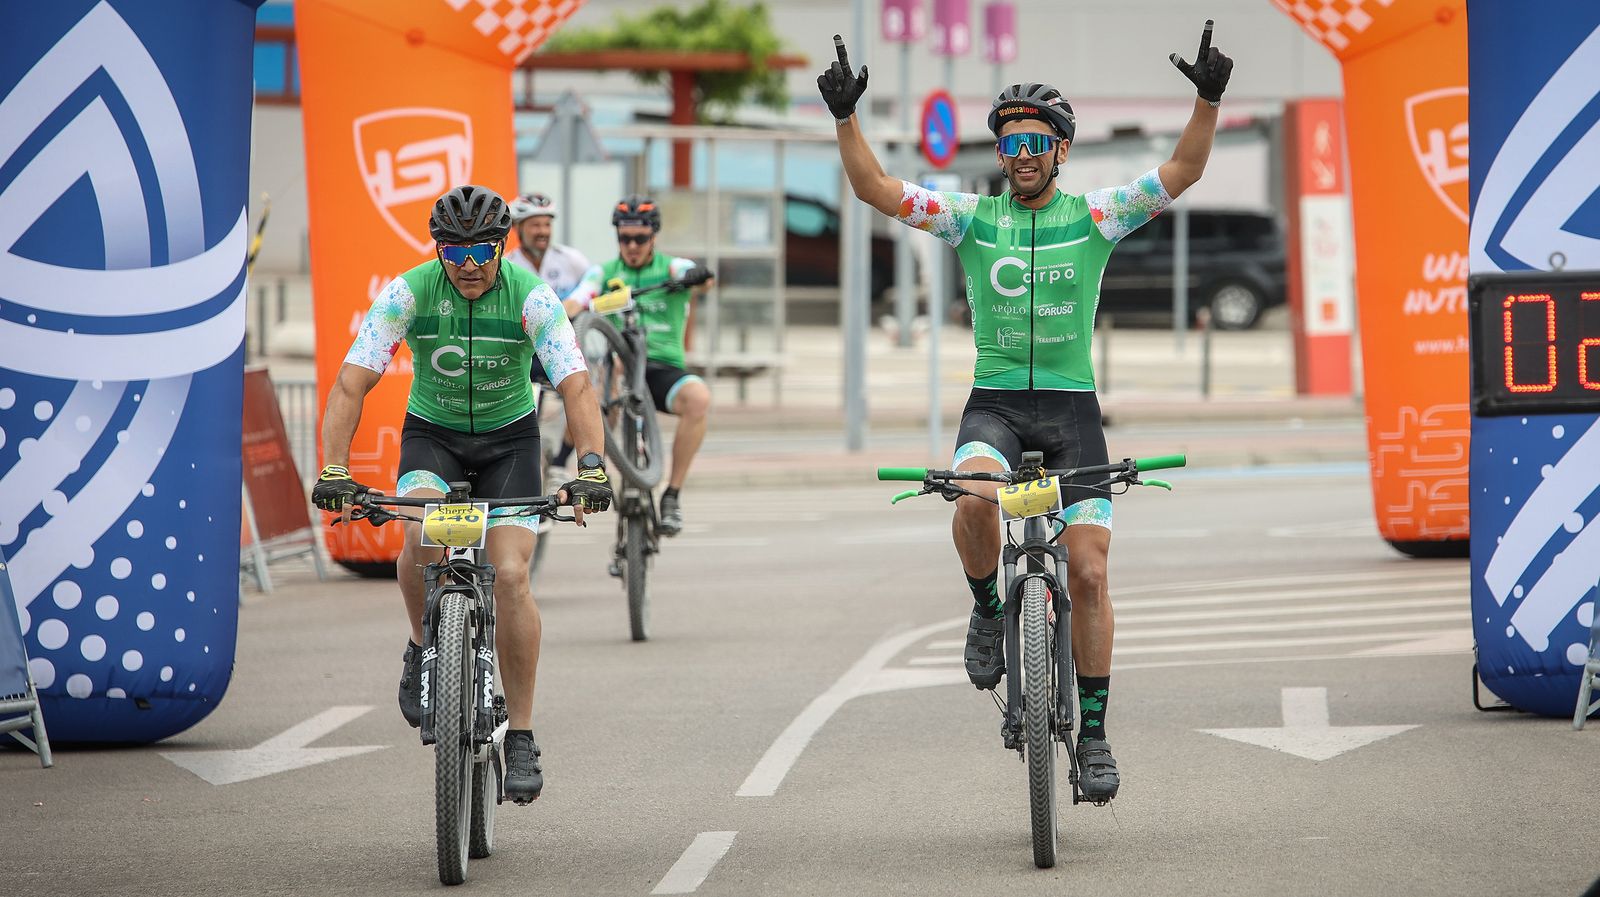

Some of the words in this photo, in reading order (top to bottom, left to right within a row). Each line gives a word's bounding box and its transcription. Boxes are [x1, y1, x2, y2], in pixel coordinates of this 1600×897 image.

[990, 256, 1075, 297] Carpo
[1038, 305, 1073, 316] CARUSO
[431, 345, 509, 377] Carpo
[476, 378, 511, 391] CARUSO
[421, 646, 438, 662] 32
[477, 646, 493, 662] 32
